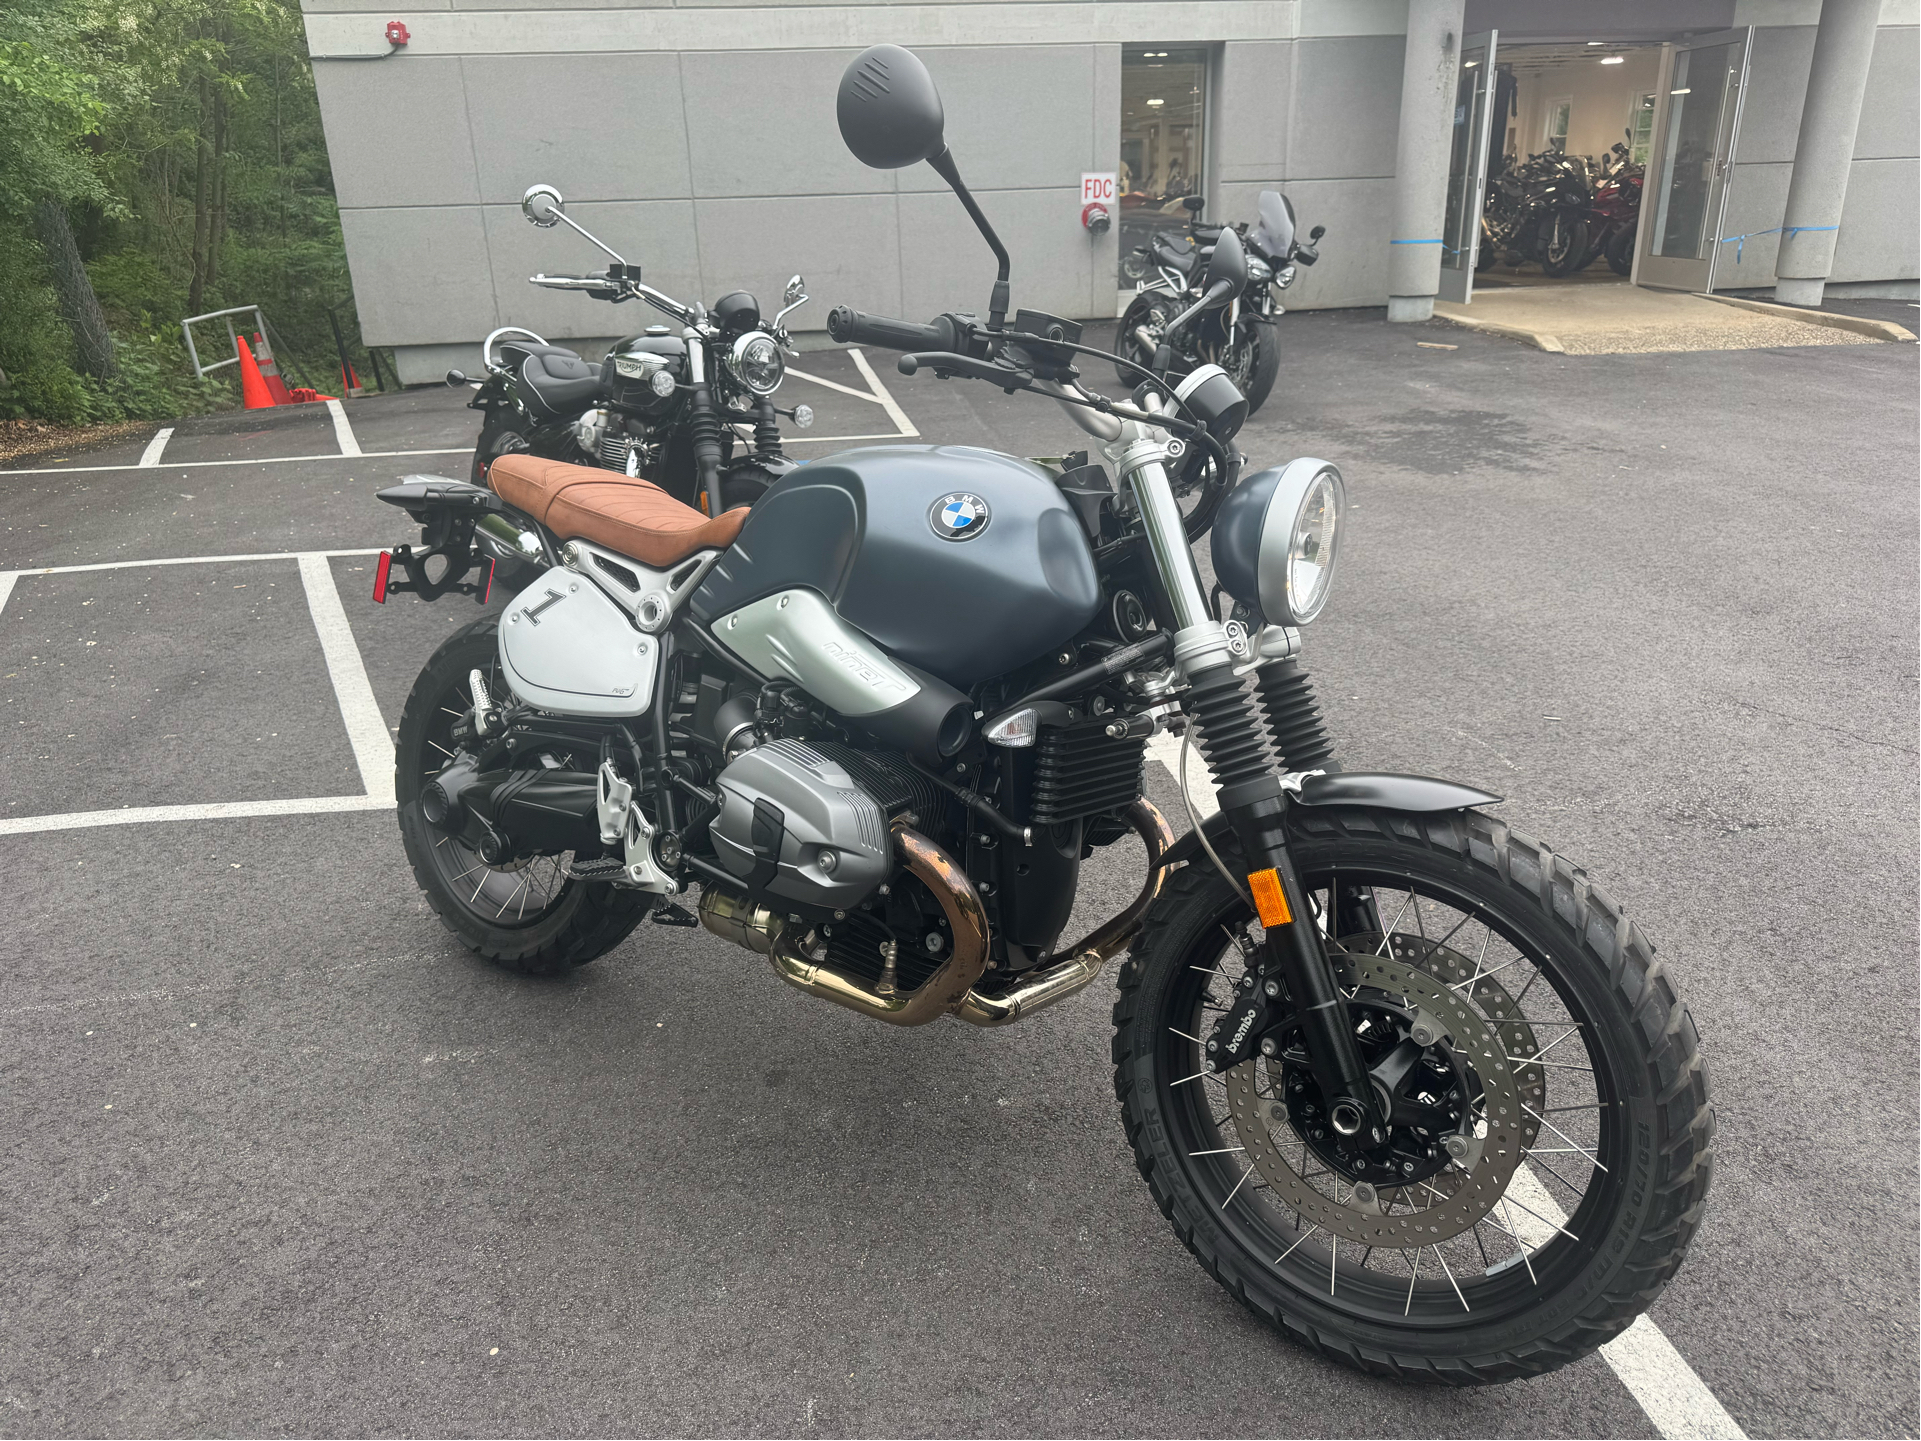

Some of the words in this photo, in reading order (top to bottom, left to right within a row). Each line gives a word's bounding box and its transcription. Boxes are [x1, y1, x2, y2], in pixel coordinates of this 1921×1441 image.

[1084, 178, 1112, 199] FDC
[617, 361, 642, 372] TRIUMPH
[945, 495, 984, 513] BMW
[520, 588, 567, 627] 1
[1225, 1009, 1256, 1054] brembo
[1144, 1107, 1221, 1245] METZELER
